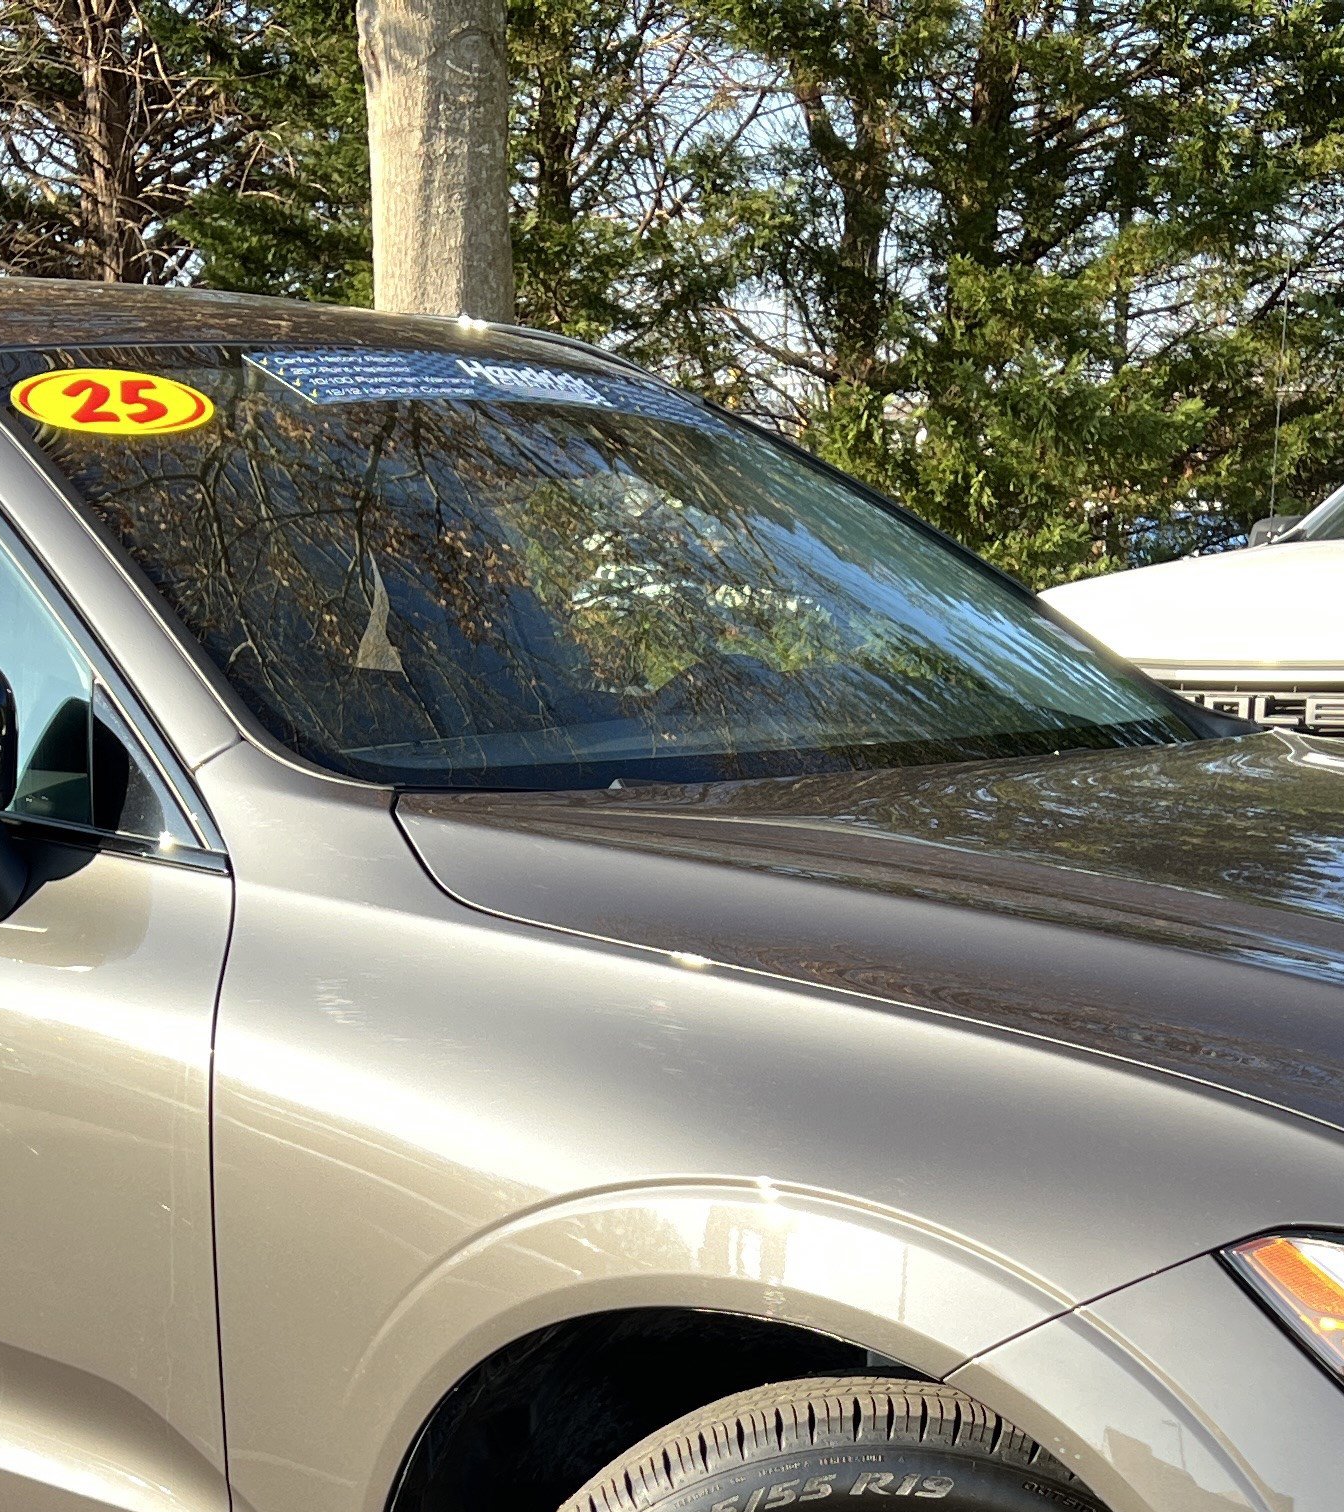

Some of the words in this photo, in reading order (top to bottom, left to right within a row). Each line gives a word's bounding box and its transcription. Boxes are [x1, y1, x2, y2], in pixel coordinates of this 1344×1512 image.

[308, 375, 354, 387] 10/100
[456, 359, 609, 398] Hendrick
[62, 379, 168, 423] 25
[848, 1471, 955, 1499] R19
